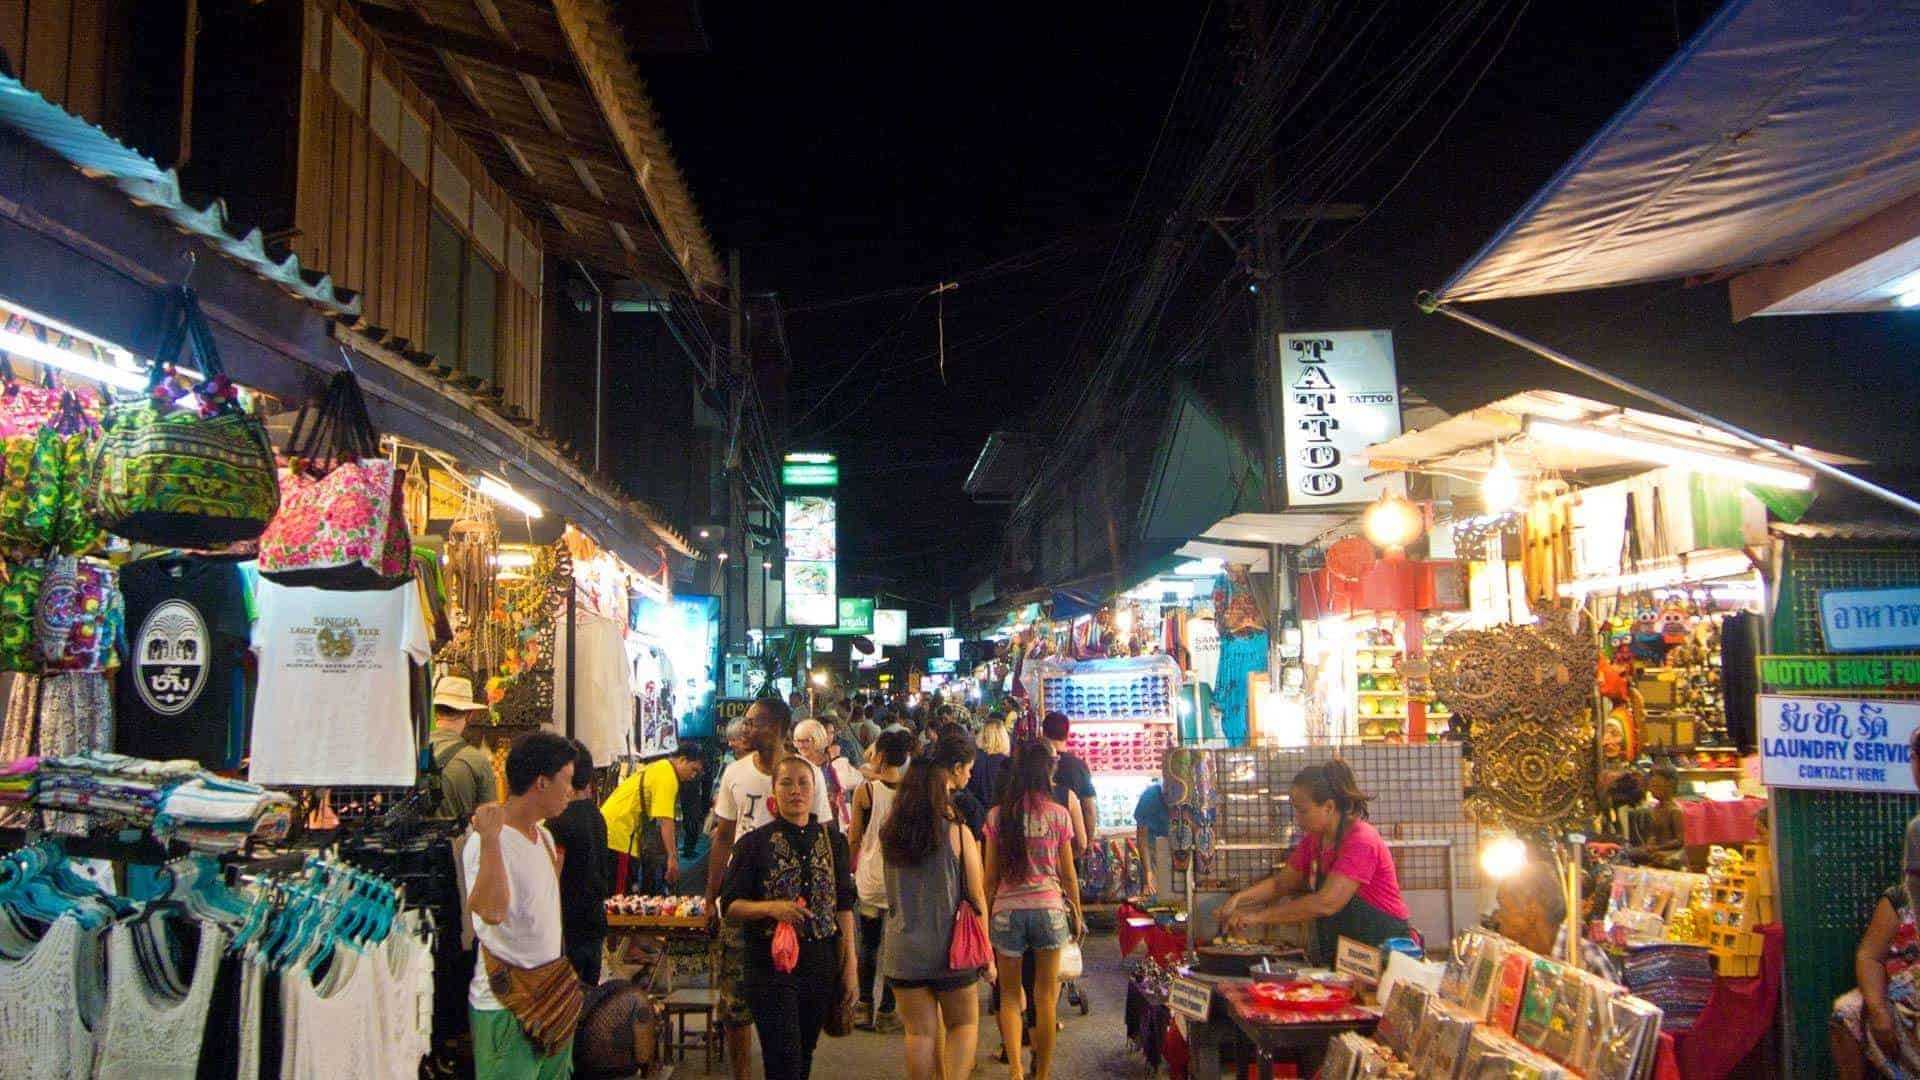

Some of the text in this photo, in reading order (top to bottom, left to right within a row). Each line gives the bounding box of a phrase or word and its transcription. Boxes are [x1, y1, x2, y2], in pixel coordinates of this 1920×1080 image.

[1346, 394, 1393, 403] TATTOO
[1289, 339, 1342, 496] TATTOO
[1763, 660, 1831, 685] MOTOR
[1837, 660, 1884, 685] BIKE
[1764, 738, 1912, 763] LAUNDRY SERVIC
[1799, 764, 1888, 782] CONTACT HERE
